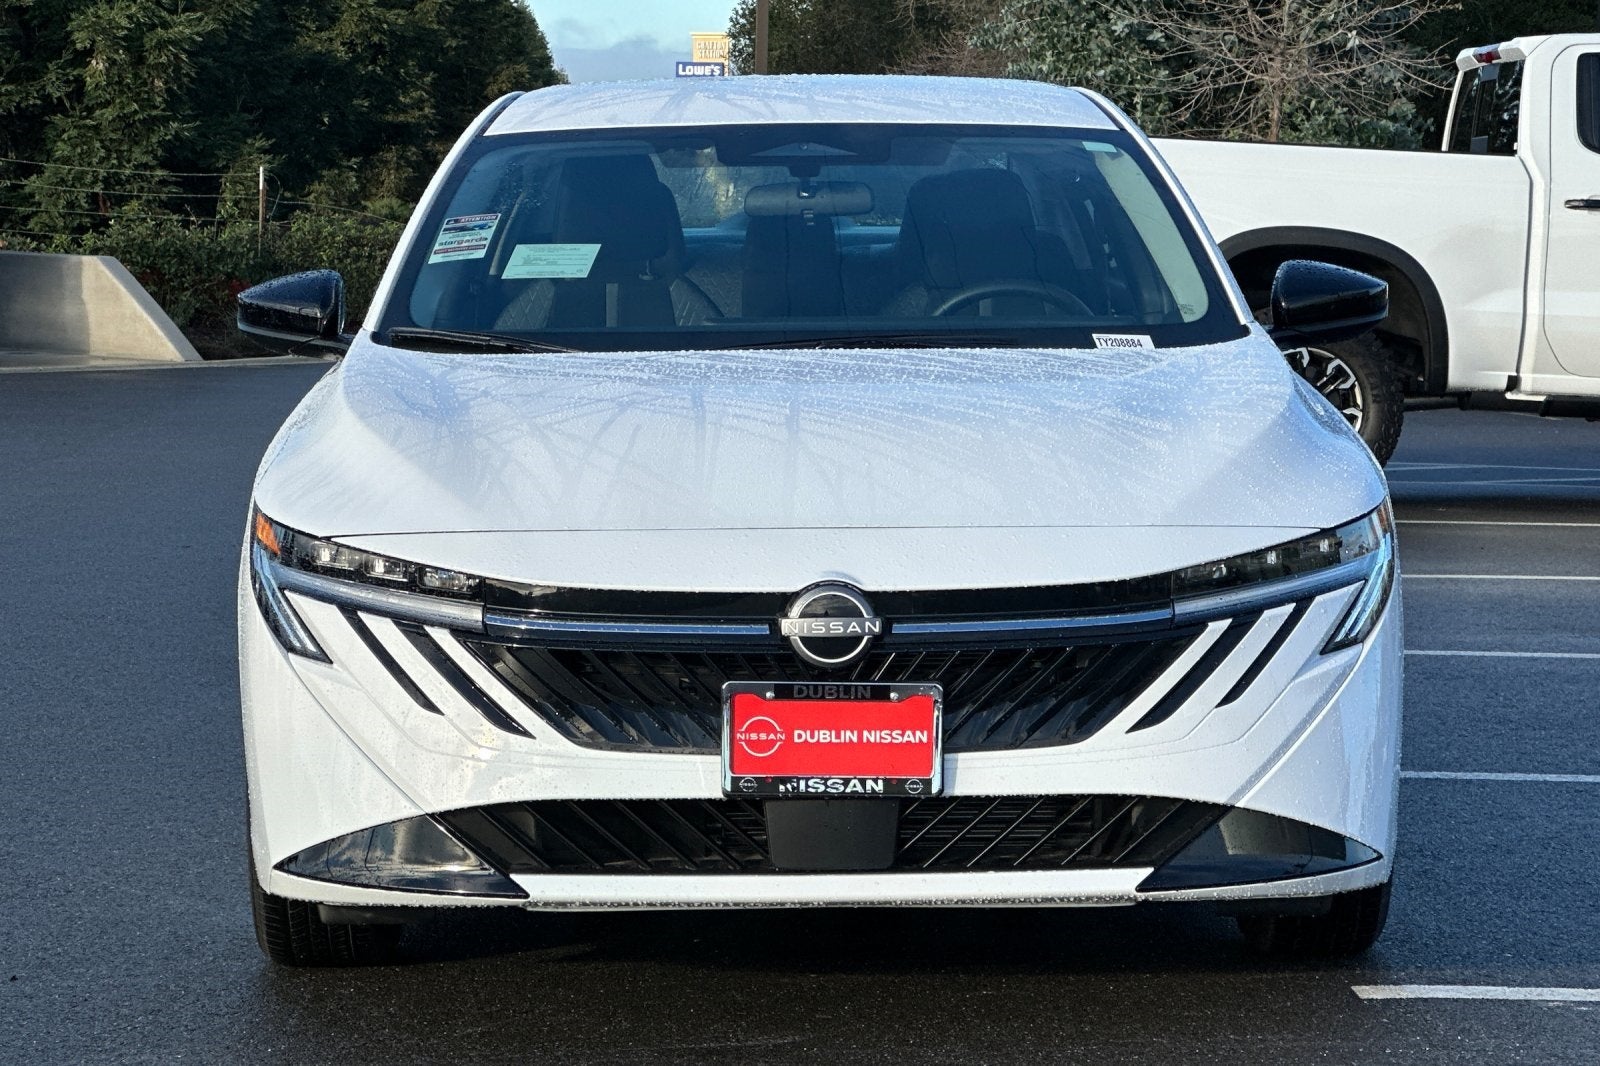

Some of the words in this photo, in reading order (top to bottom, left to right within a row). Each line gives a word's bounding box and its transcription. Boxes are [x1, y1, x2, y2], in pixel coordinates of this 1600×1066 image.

[678, 63, 721, 76] LOWE'S
[460, 214, 498, 223] ATTENTION
[1096, 337, 1143, 348] TY208884
[785, 620, 880, 634] NISSAN
[793, 685, 871, 699] DUBLIN
[736, 732, 786, 741] NISSAN
[793, 729, 858, 743] DUBLIN
[863, 729, 928, 743] NISSAN
